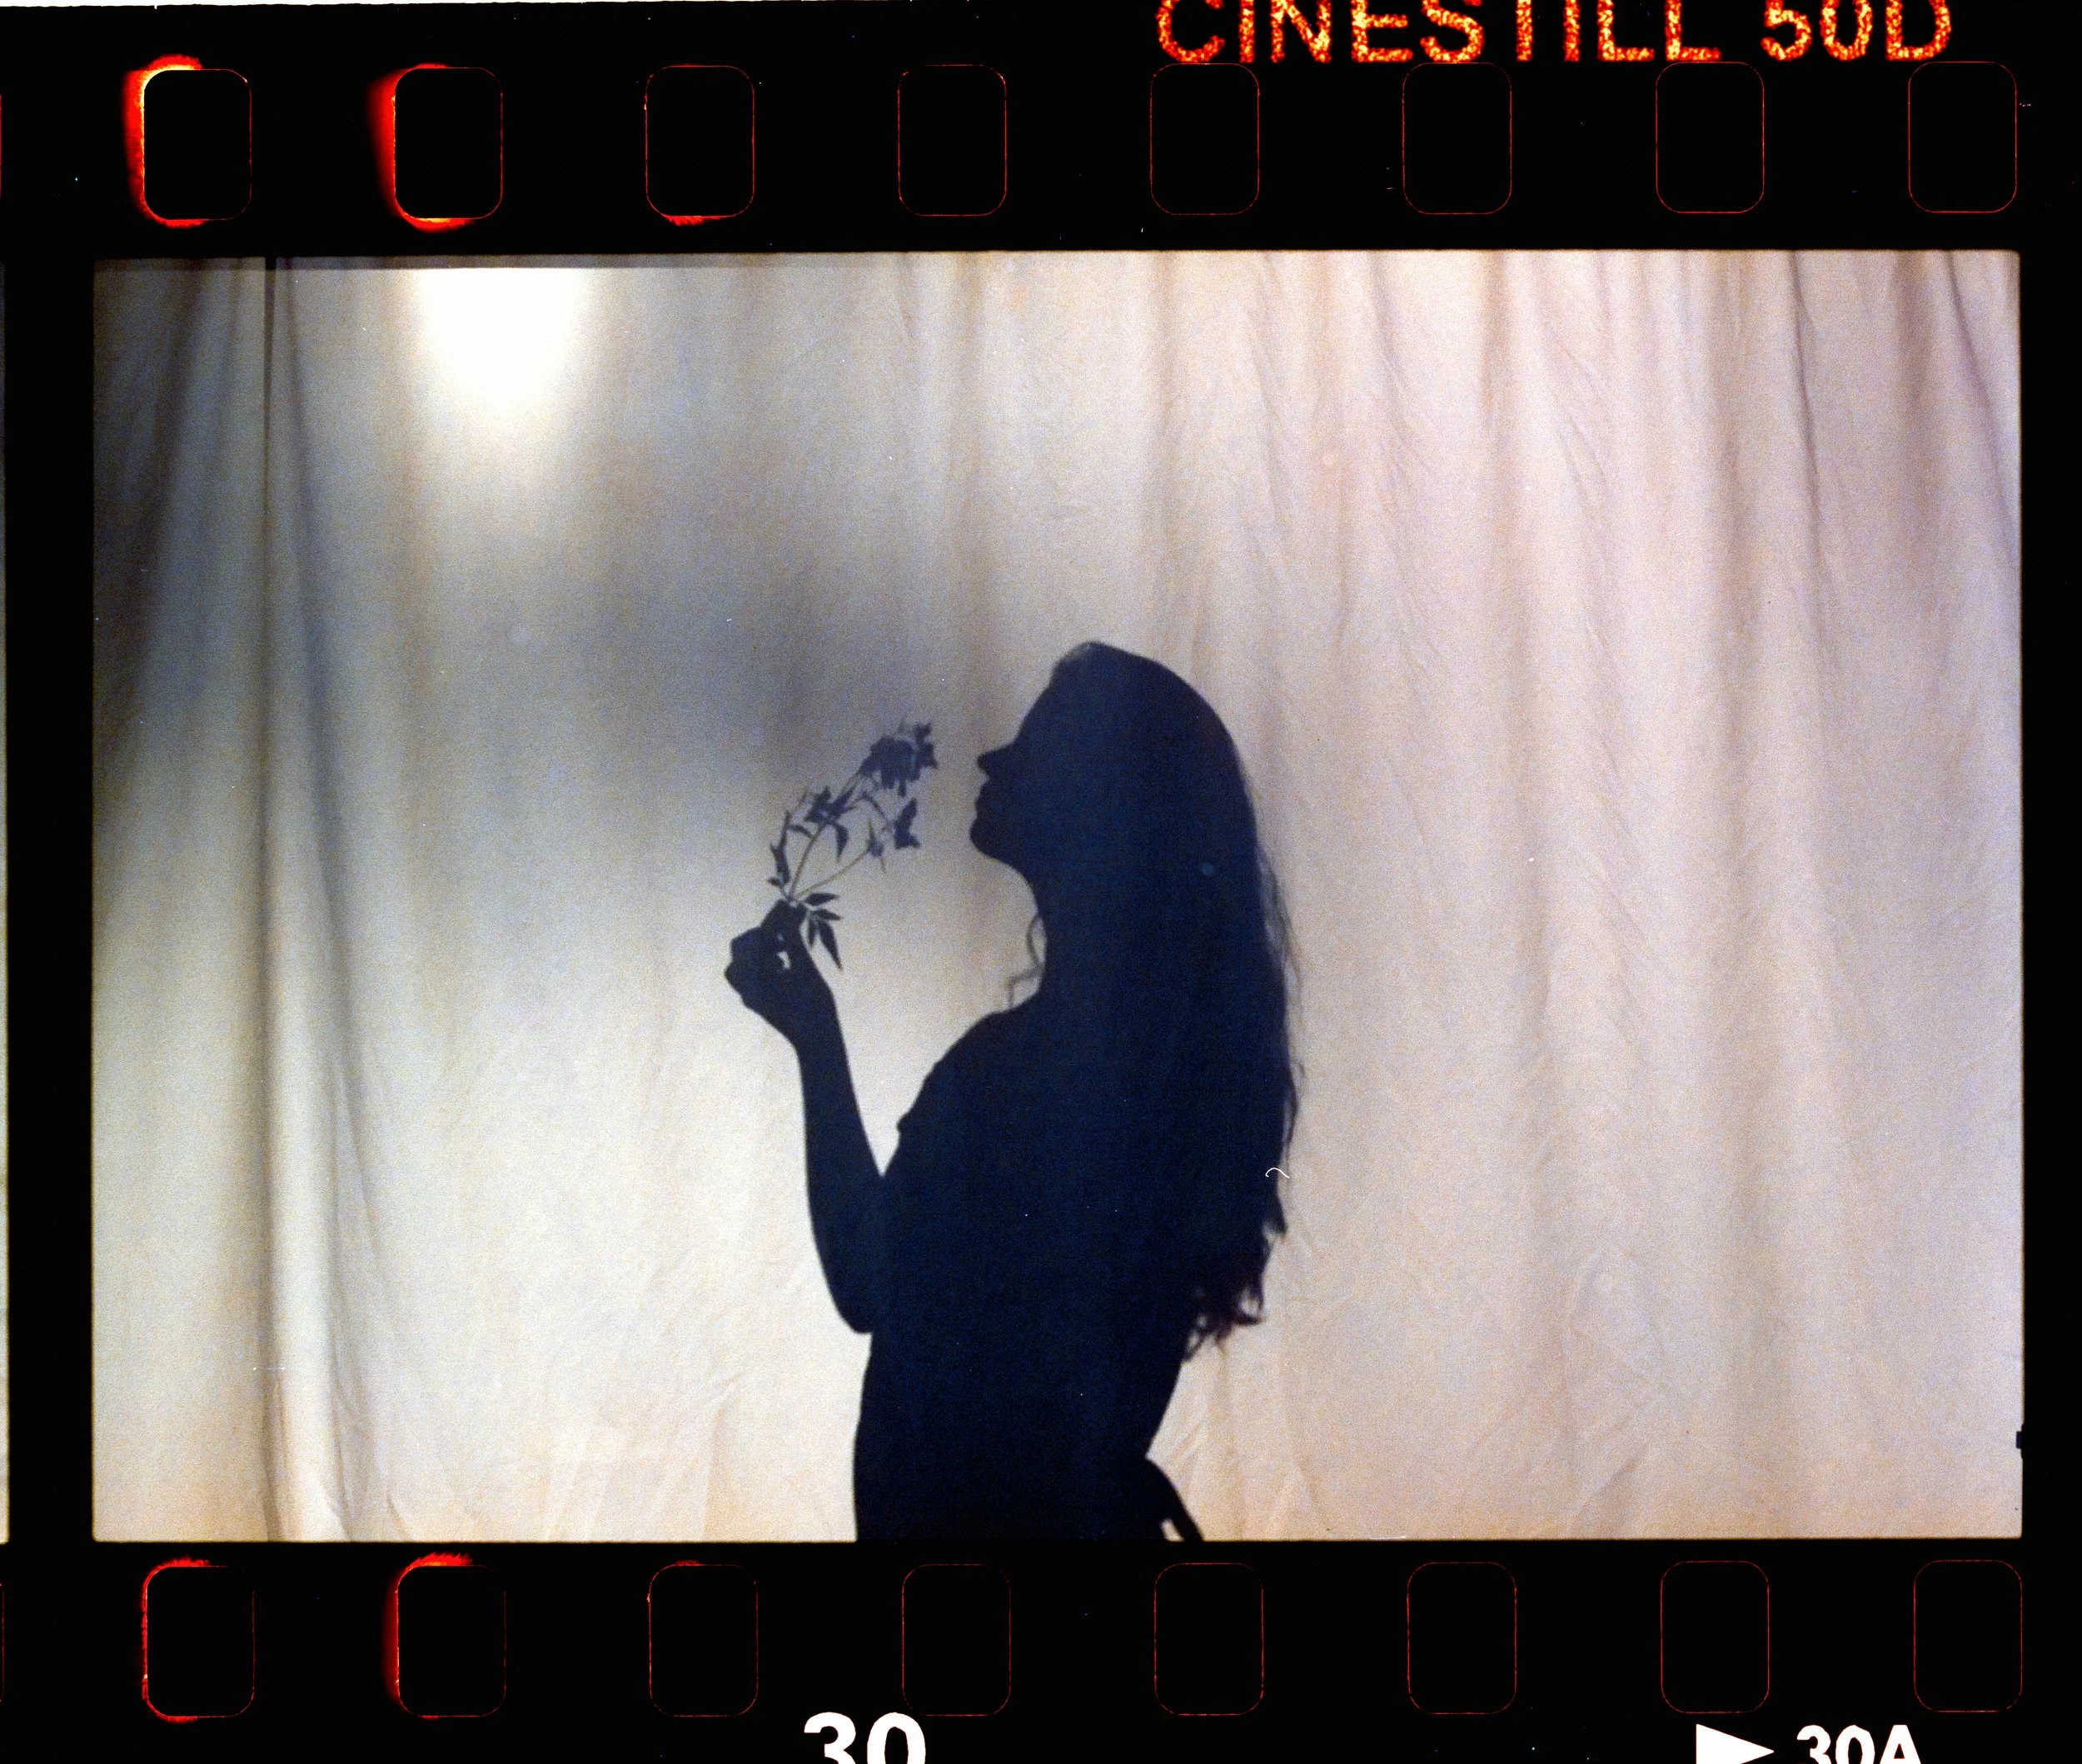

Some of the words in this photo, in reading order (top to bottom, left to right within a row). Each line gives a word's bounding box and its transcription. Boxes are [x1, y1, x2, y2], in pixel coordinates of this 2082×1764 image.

[1156, 0, 1722, 63] CINESTILL
[1761, 0, 1952, 62] 50D
[804, 1712, 927, 1764] 30
[1796, 1724, 1922, 1764] 30A
